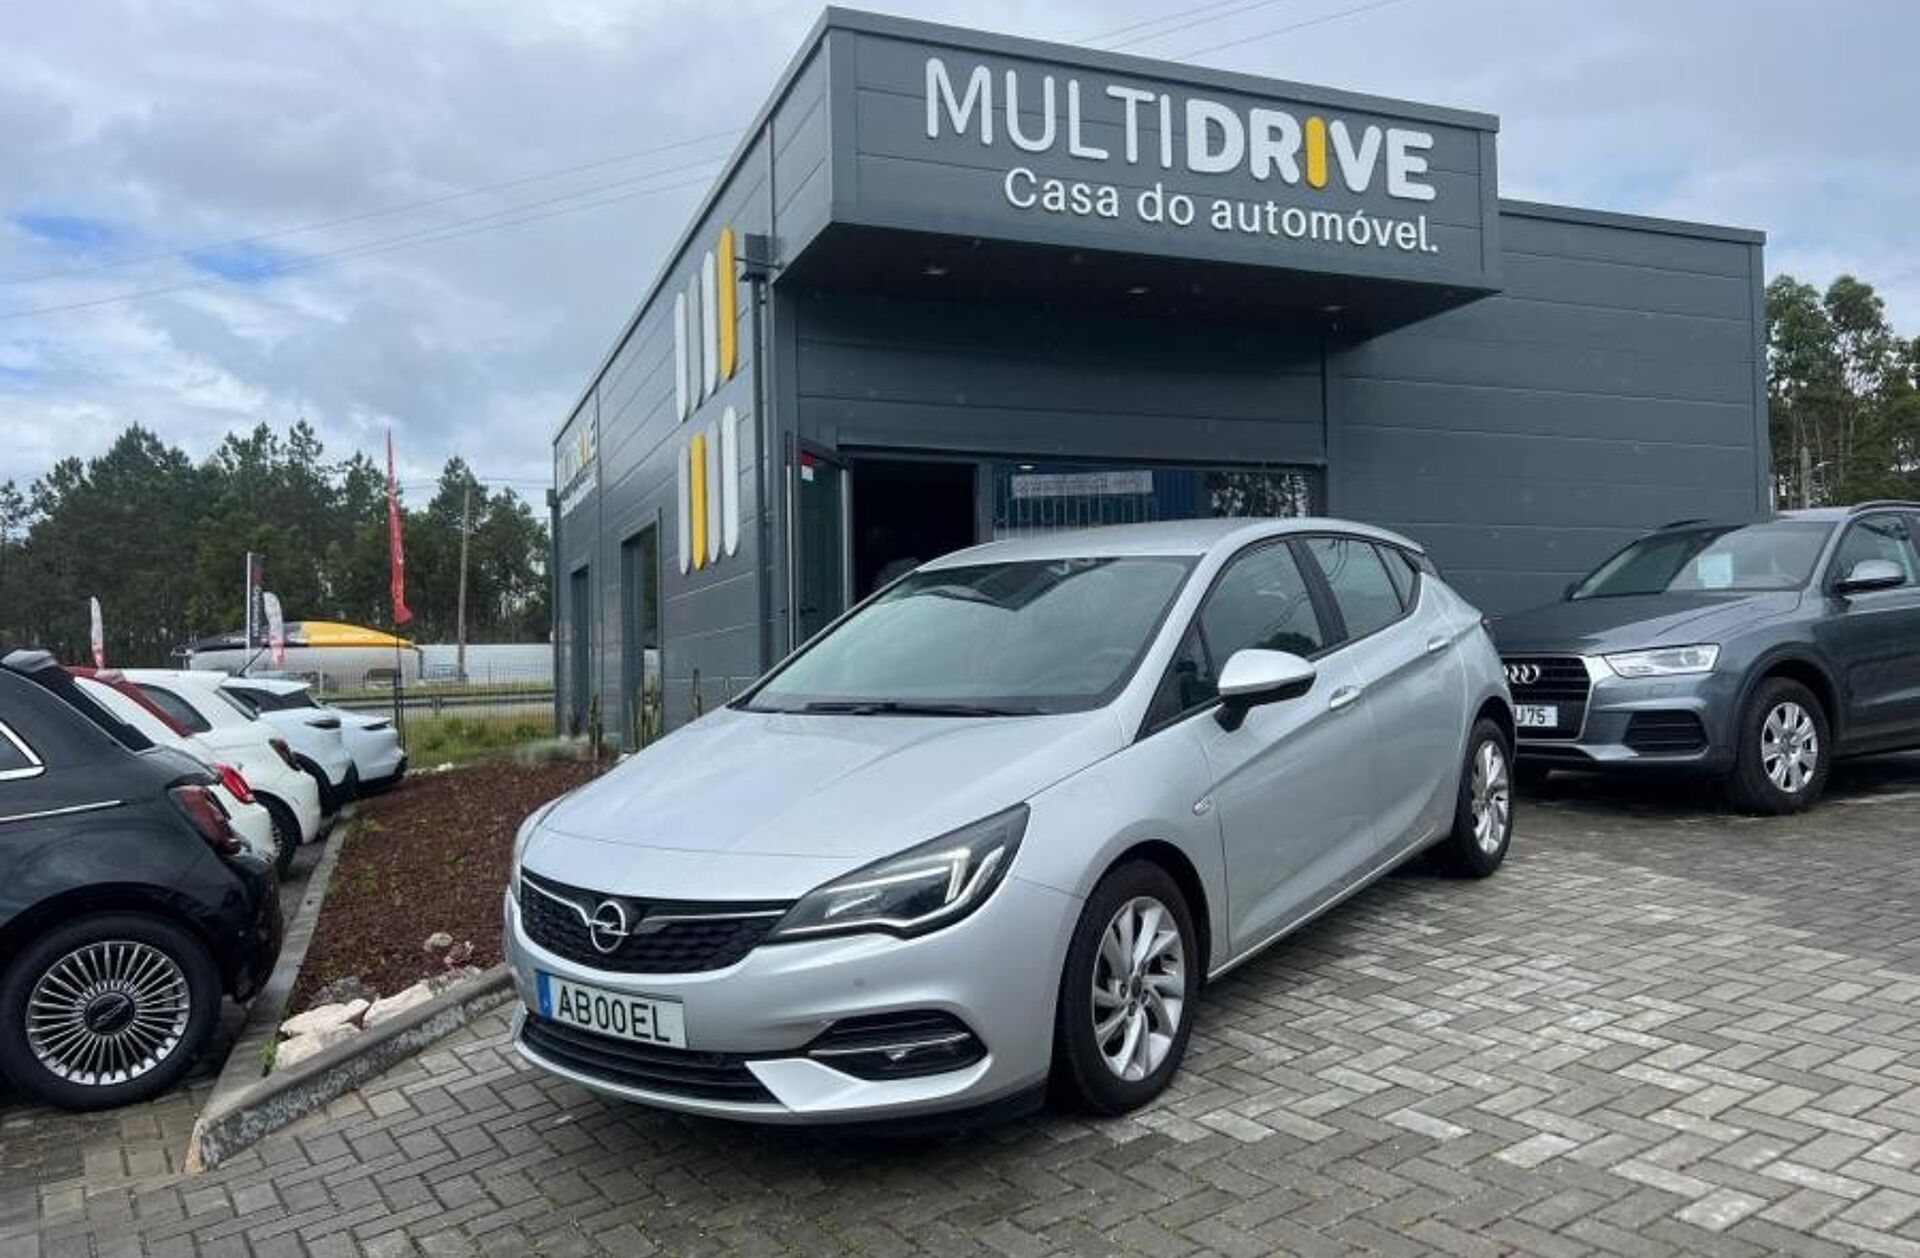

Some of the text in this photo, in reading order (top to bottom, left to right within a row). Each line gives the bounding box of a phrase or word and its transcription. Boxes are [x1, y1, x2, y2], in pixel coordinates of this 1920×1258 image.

[925, 57, 1437, 201] MULTIDRIVE
[1003, 167, 1438, 253] Casa do automóvel.
